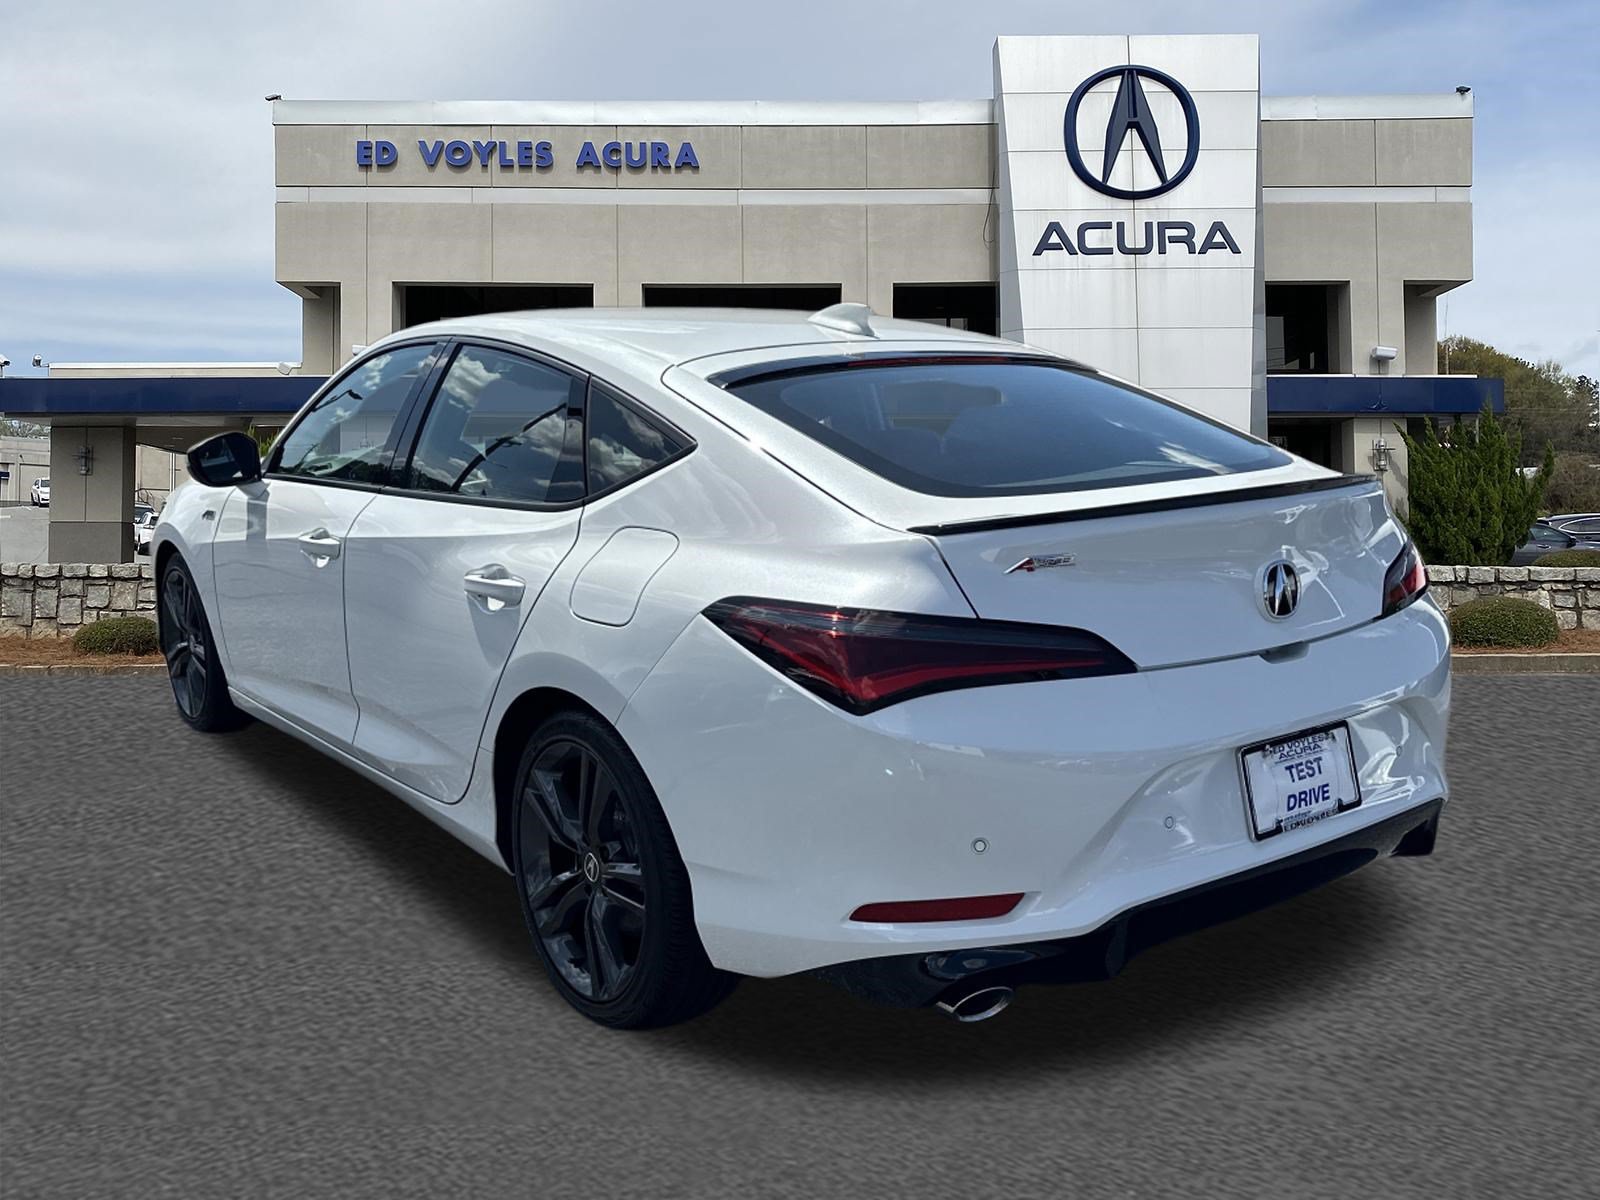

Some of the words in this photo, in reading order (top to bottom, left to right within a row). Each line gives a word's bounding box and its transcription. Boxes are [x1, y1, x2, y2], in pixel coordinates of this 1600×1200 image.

[356, 140, 397, 167] ED
[417, 140, 554, 168] VOYLES
[576, 141, 700, 168] ACURA
[1032, 221, 1242, 256] ACURA
[1278, 743, 1322, 760] ACURA
[1285, 756, 1323, 783] TEST
[1287, 783, 1330, 812] DRIVE
